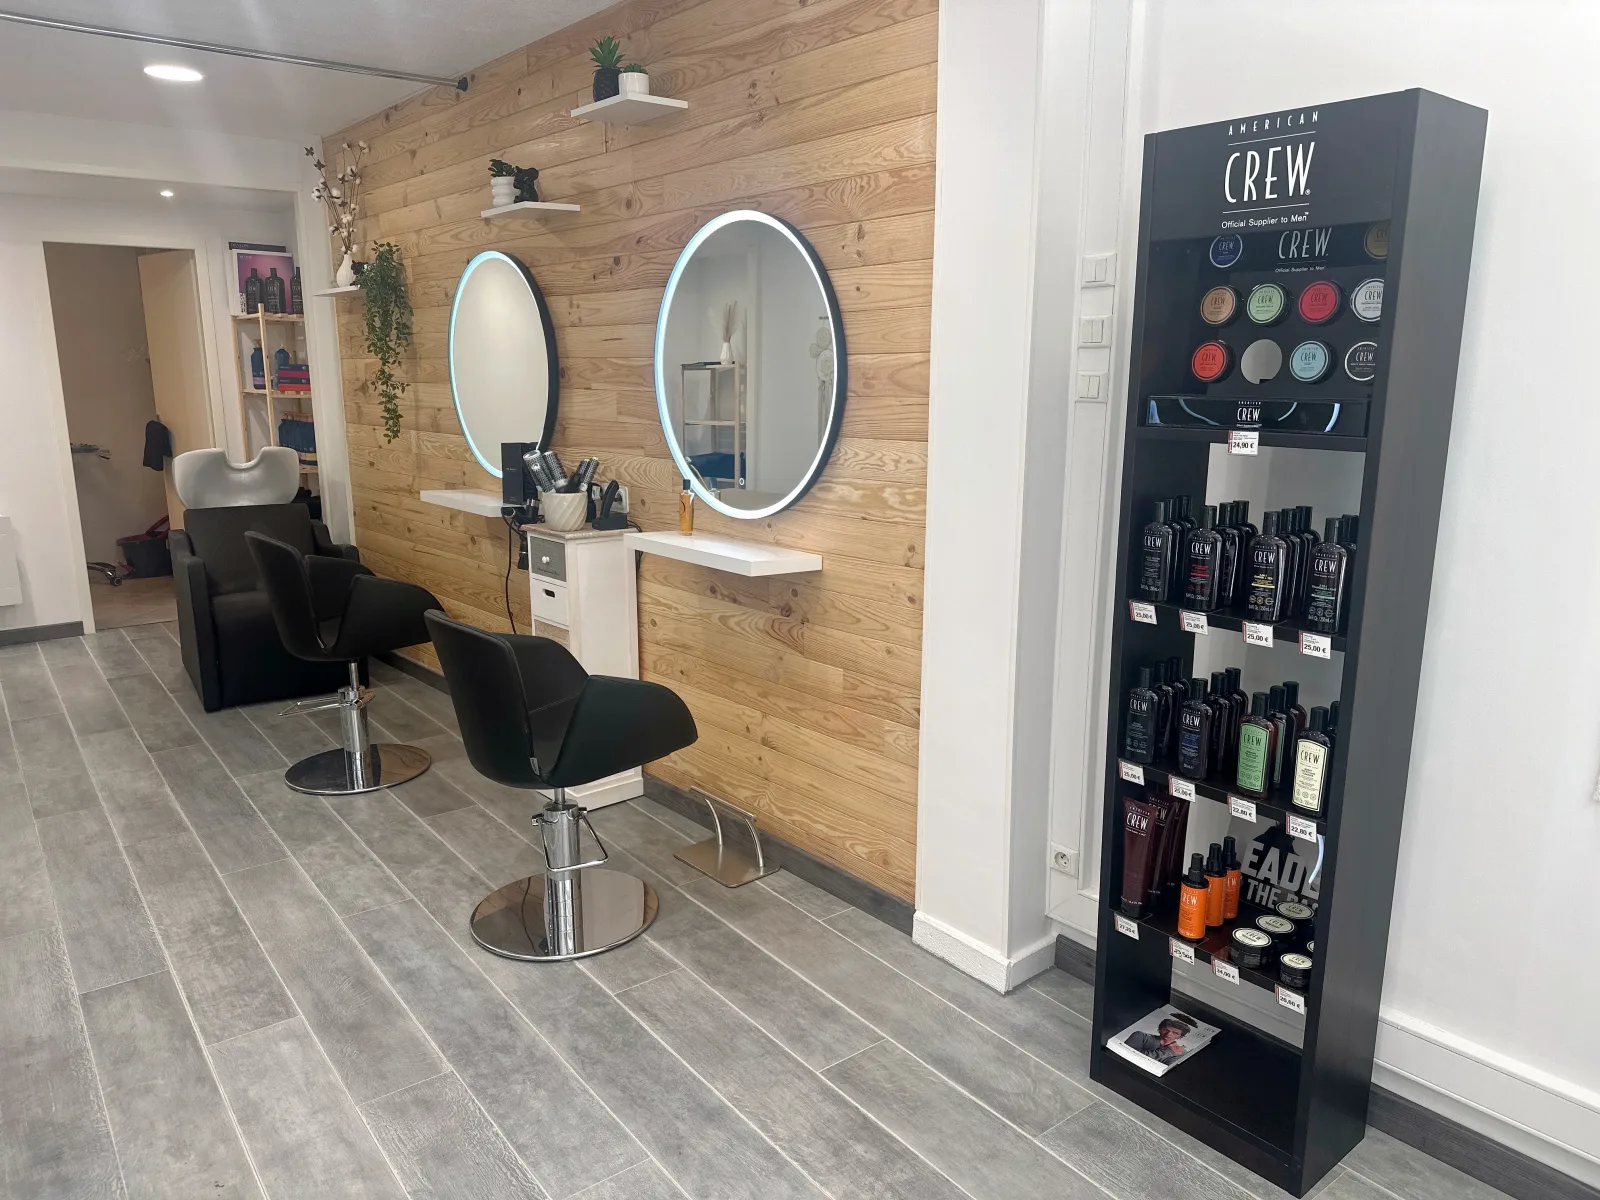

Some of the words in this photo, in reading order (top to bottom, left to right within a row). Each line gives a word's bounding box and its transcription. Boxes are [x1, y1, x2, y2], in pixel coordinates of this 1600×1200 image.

[1228, 110, 1319, 136] AMERICAN
[1223, 141, 1316, 204] CREW
[1221, 220, 1246, 229] Official
[1248, 217, 1278, 228] Supplier
[1218, 240, 1235, 251] CREW
[1277, 227, 1333, 260] CREW
[1300, 351, 1318, 362] CREW
[1355, 351, 1374, 362] CREW
[1237, 407, 1261, 422] CREW
[1232, 441, 1249, 450] 24,90
[1144, 535, 1162, 548] CREW
[1191, 541, 1212, 555] CREW
[1254, 550, 1276, 564] CREW
[1314, 559, 1337, 573] CREW
[1247, 633, 1264, 642] 25,00
[1303, 643, 1321, 653] 25,00
[1129, 698, 1148, 712] CREW
[1182, 713, 1201, 727] CREW
[1243, 733, 1262, 746] CREW
[1300, 750, 1321, 765] CREW
[1126, 812, 1149, 830] CREW
[1246, 878, 1282, 909] THE
